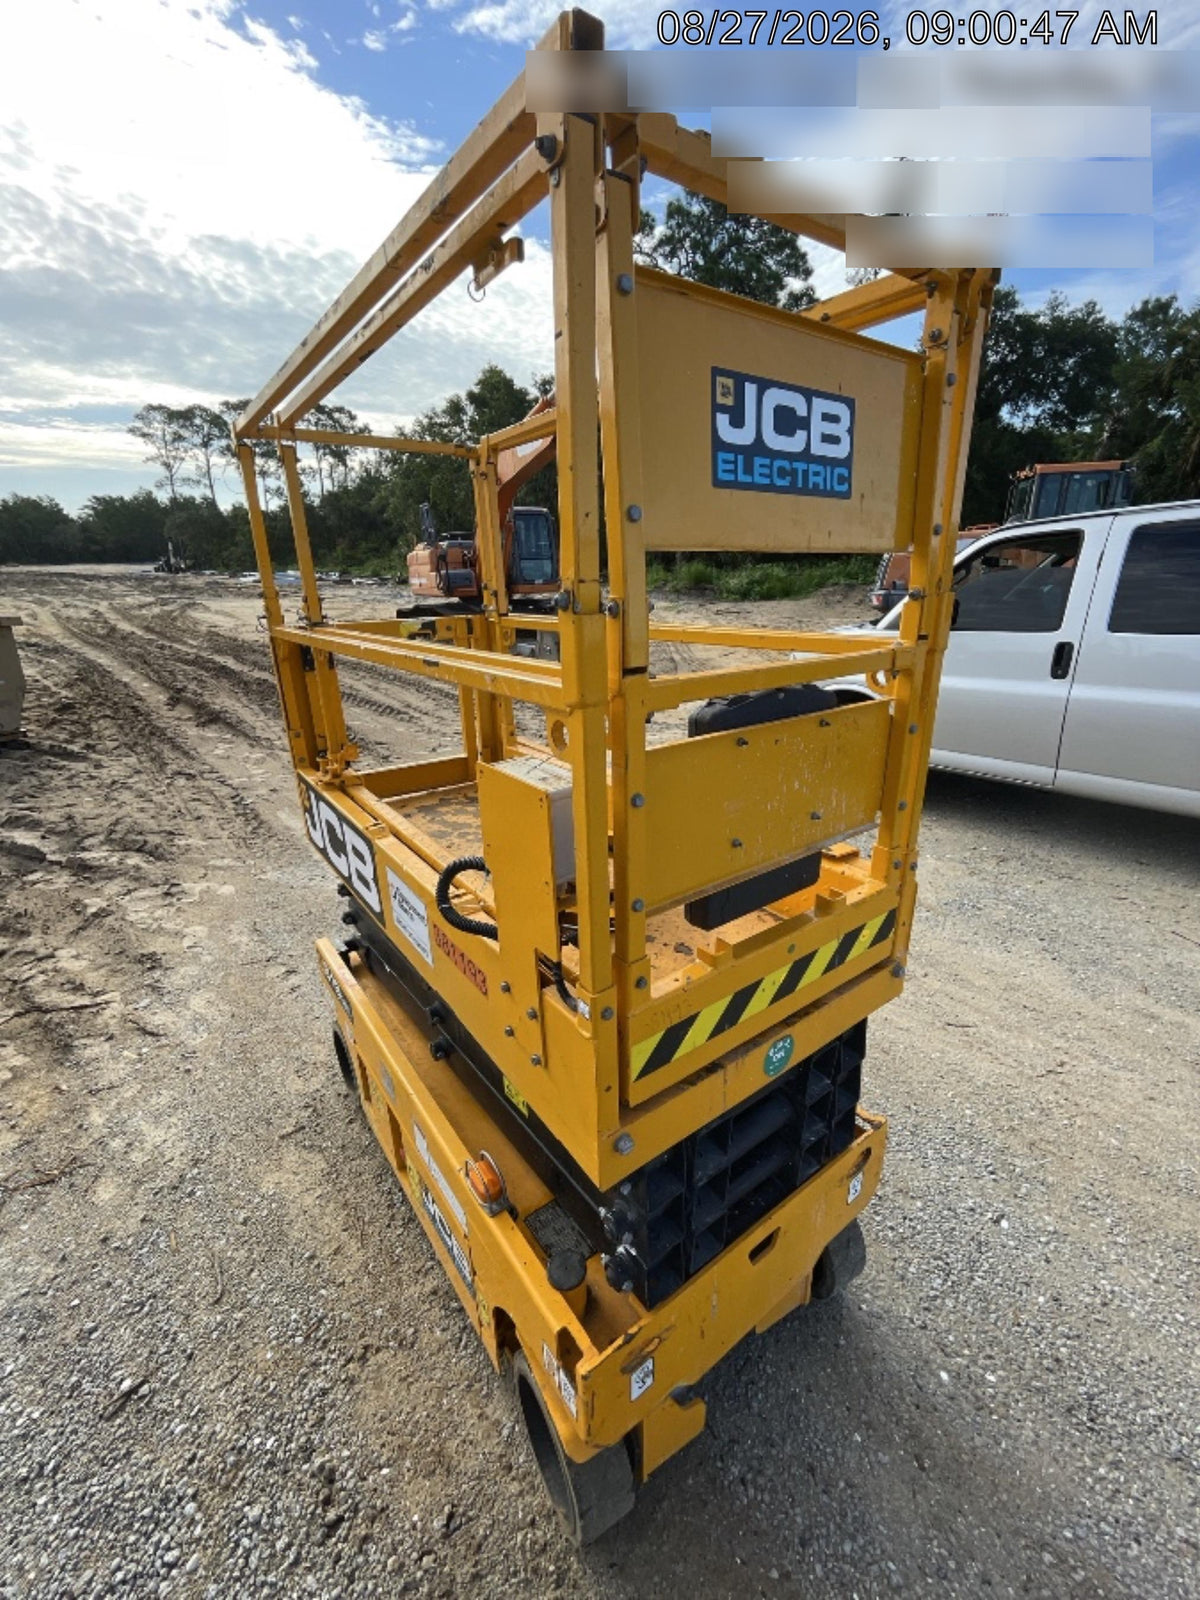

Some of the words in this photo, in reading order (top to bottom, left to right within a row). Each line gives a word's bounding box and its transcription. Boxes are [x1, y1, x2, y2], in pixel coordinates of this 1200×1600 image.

[716, 381, 851, 460] JCB
[716, 451, 850, 492] ELECTRIC
[305, 790, 381, 913] JCB
